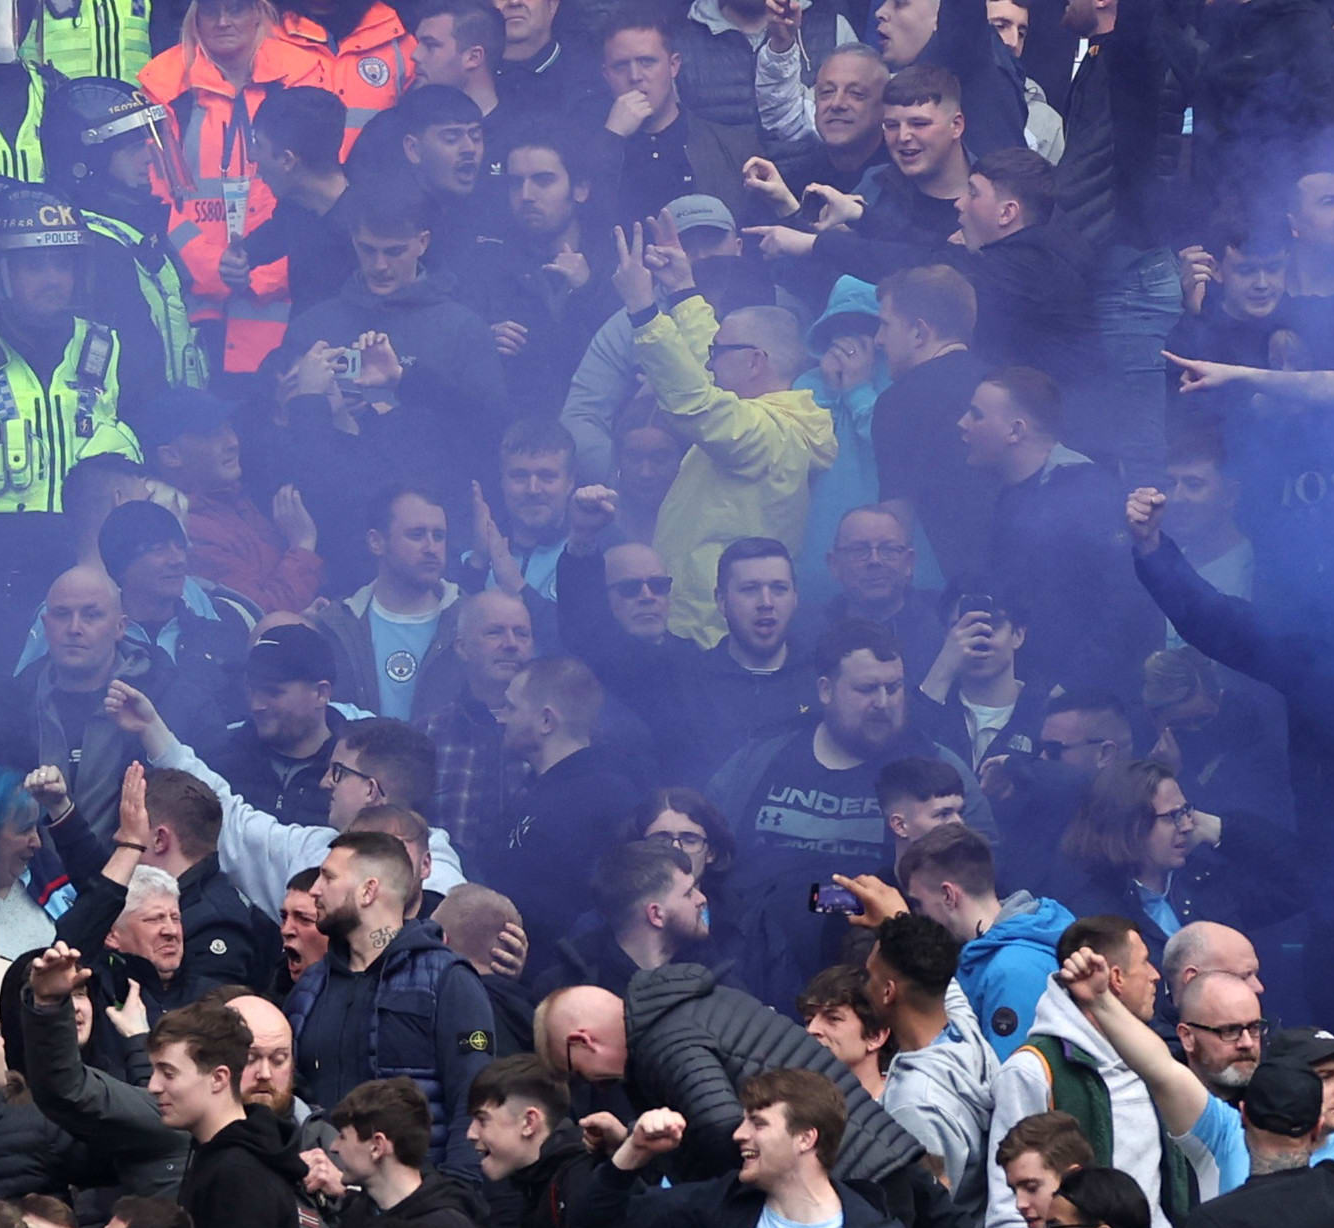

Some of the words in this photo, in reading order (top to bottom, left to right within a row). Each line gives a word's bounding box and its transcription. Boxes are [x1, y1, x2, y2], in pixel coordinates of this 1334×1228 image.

[39, 205, 76, 226] CK
[44, 232, 76, 244] POLICE
[767, 785, 883, 816] UNDER
